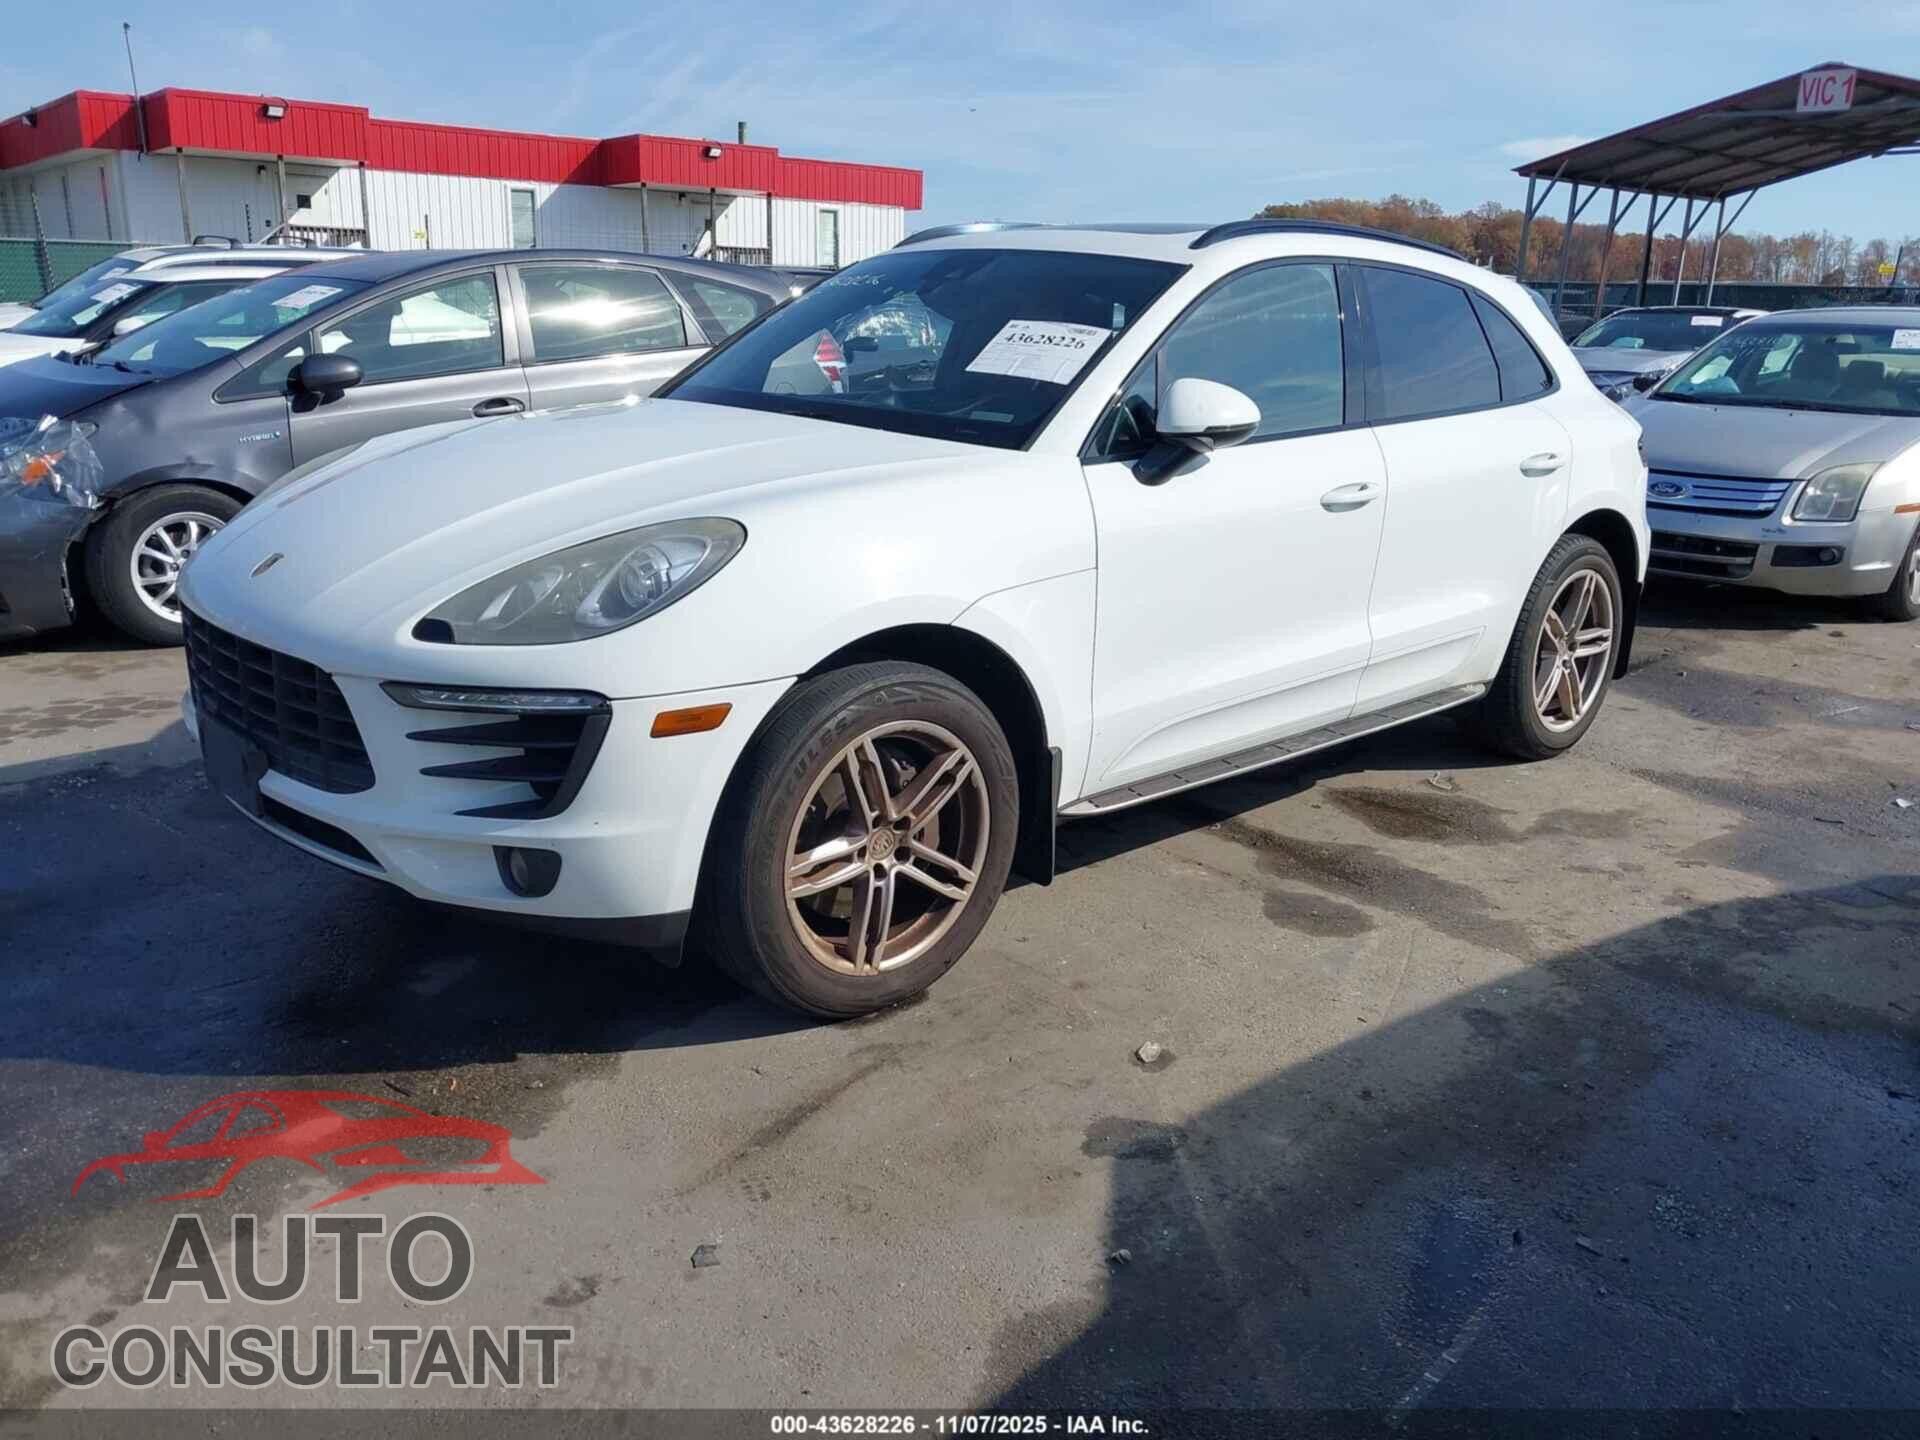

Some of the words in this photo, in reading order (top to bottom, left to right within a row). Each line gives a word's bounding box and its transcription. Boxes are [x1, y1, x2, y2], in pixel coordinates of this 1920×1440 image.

[1802, 75, 1837, 107] VIC
[1842, 73, 1855, 105] 1
[1004, 332, 1086, 350] 43628226
